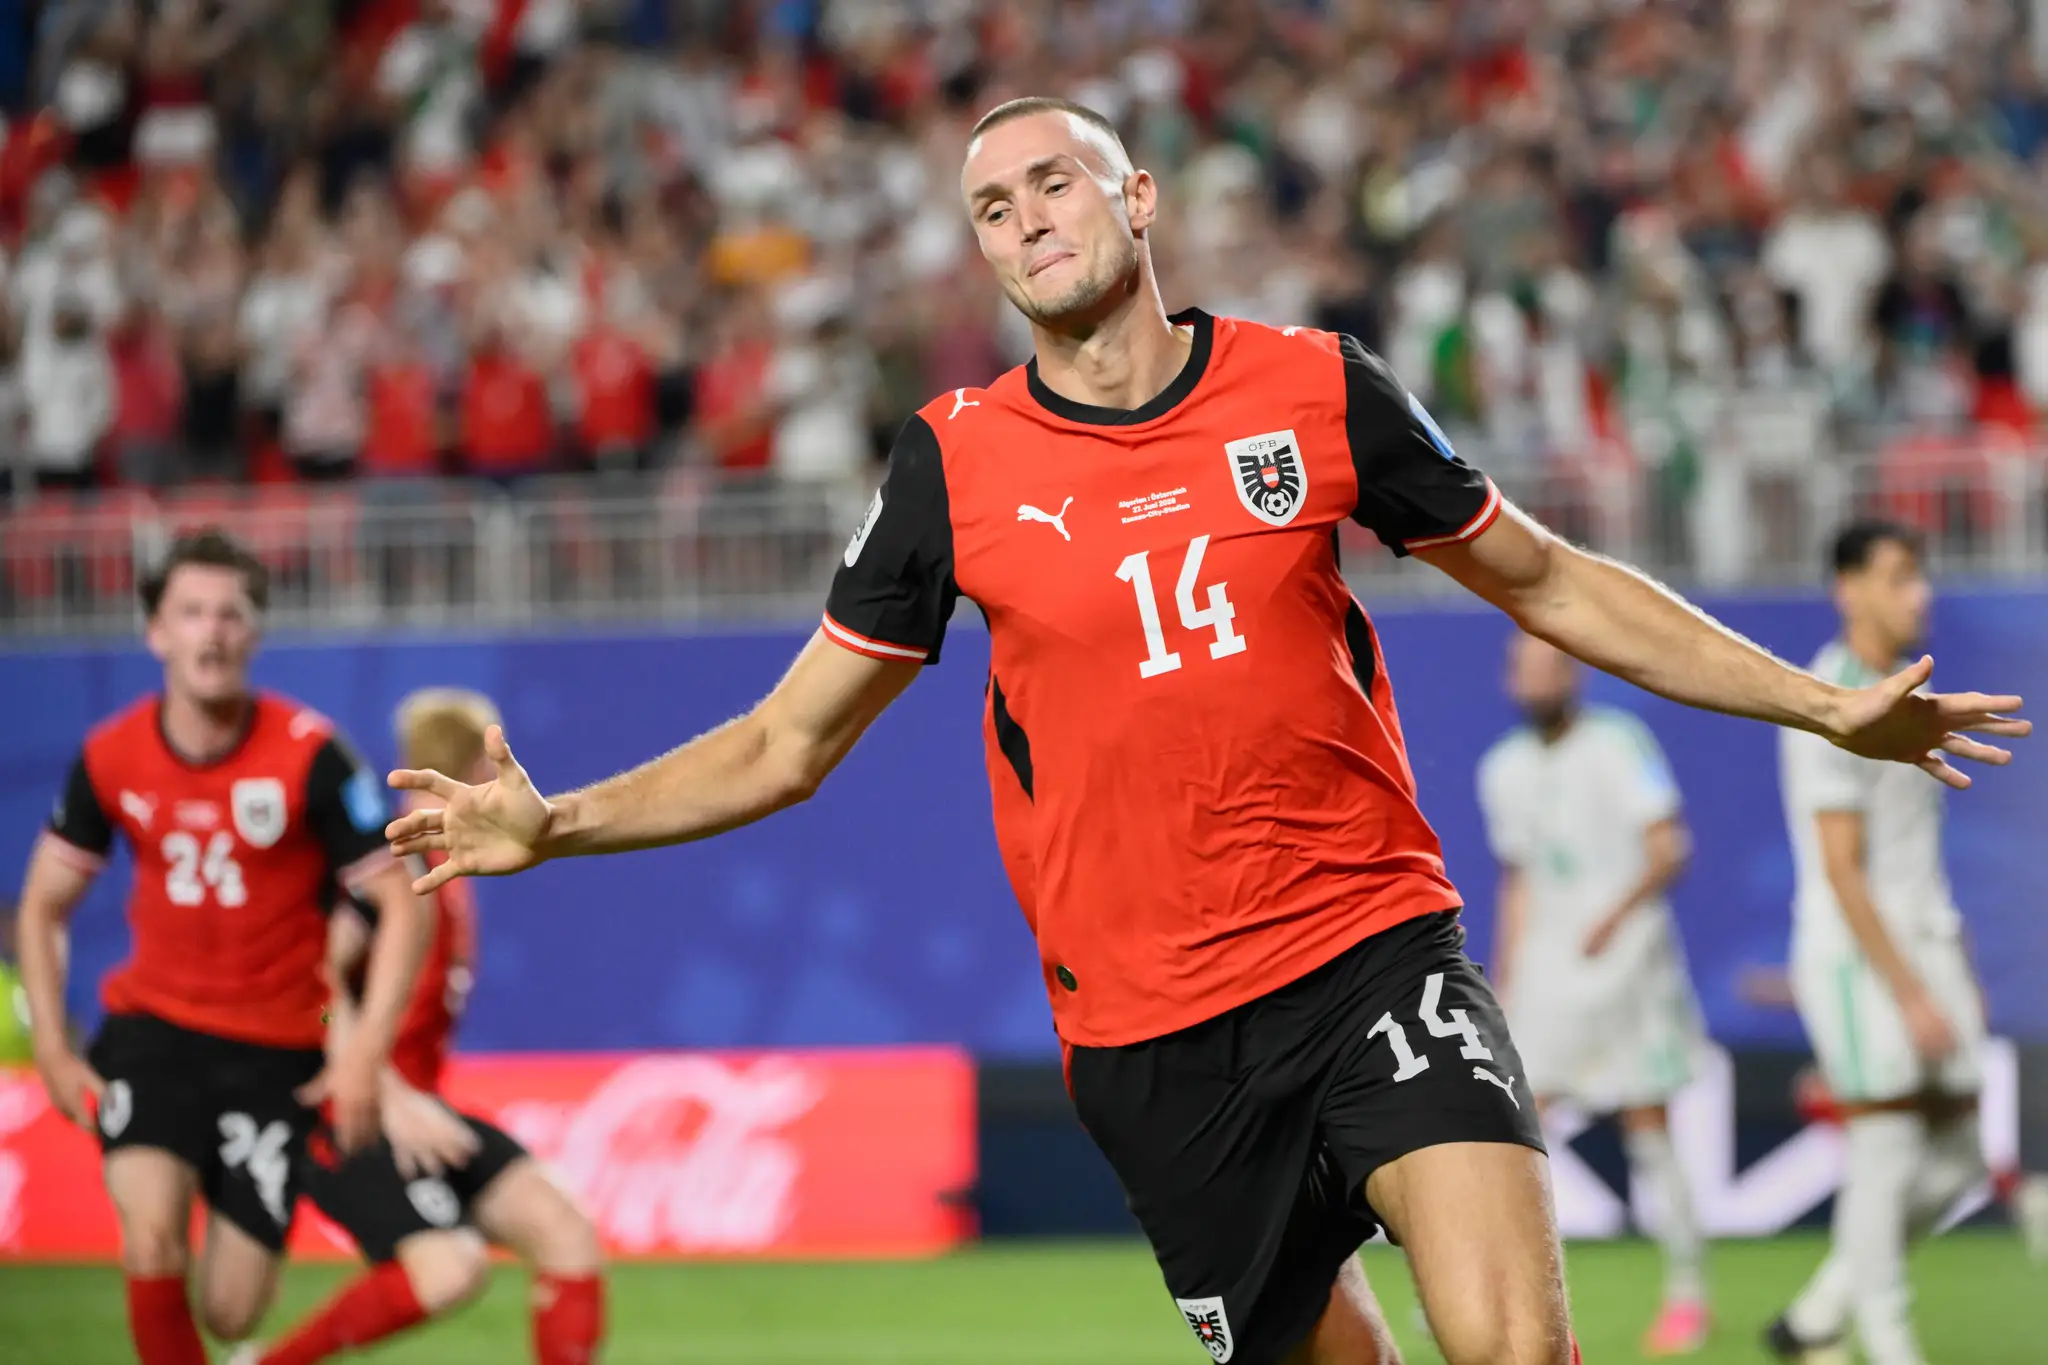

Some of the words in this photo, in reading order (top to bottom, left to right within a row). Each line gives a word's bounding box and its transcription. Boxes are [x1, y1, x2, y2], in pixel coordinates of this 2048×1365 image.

[1118, 497, 1147, 508] Algerien
[1143, 502, 1158, 511] Juni
[1115, 534, 1247, 679] 14
[161, 830, 248, 908] 24
[1366, 972, 1494, 1083] 14
